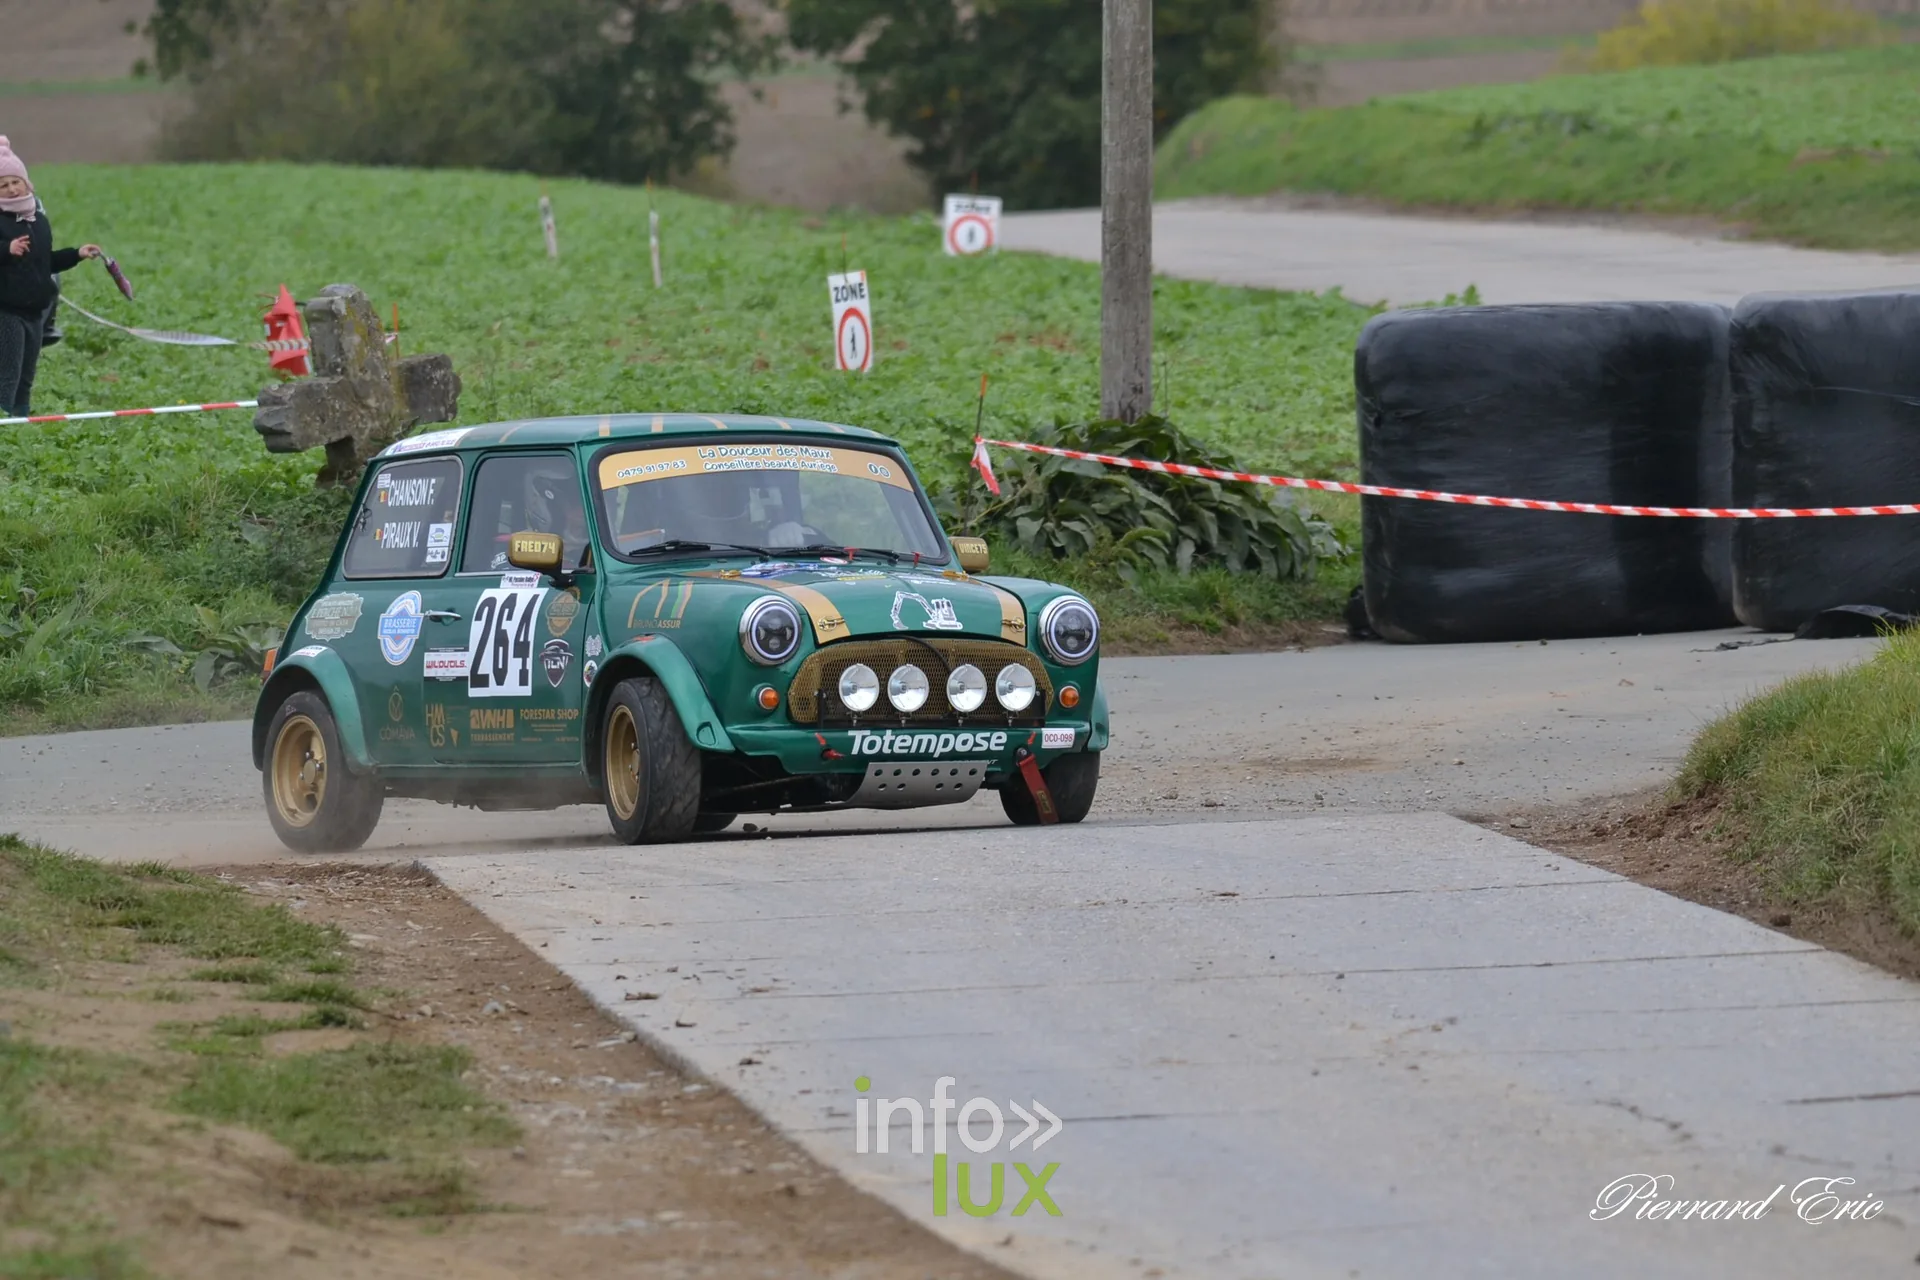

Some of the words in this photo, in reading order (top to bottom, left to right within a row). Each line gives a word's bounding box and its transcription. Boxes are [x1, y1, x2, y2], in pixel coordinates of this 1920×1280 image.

[833, 282, 866, 303] ZONE
[698, 447, 716, 459] La
[718, 446, 772, 458] Douceur
[776, 445, 798, 458] des
[799, 447, 832, 460] Maux
[618, 467, 644, 479] 0479
[645, 465, 655, 473] 91
[657, 462, 670, 471] 97
[672, 460, 686, 469] 83
[703, 458, 761, 471] Conseillère
[763, 458, 799, 470] beauté
[388, 479, 428, 507] CHANSON
[381, 522, 413, 549] PIRAUX
[514, 540, 556, 554] FRED74
[384, 618, 417, 629] BRASSERIE
[471, 593, 540, 688] 264
[520, 709, 556, 720] FORESTAR
[557, 708, 579, 720] SHOP
[848, 729, 1007, 758] Totempose
